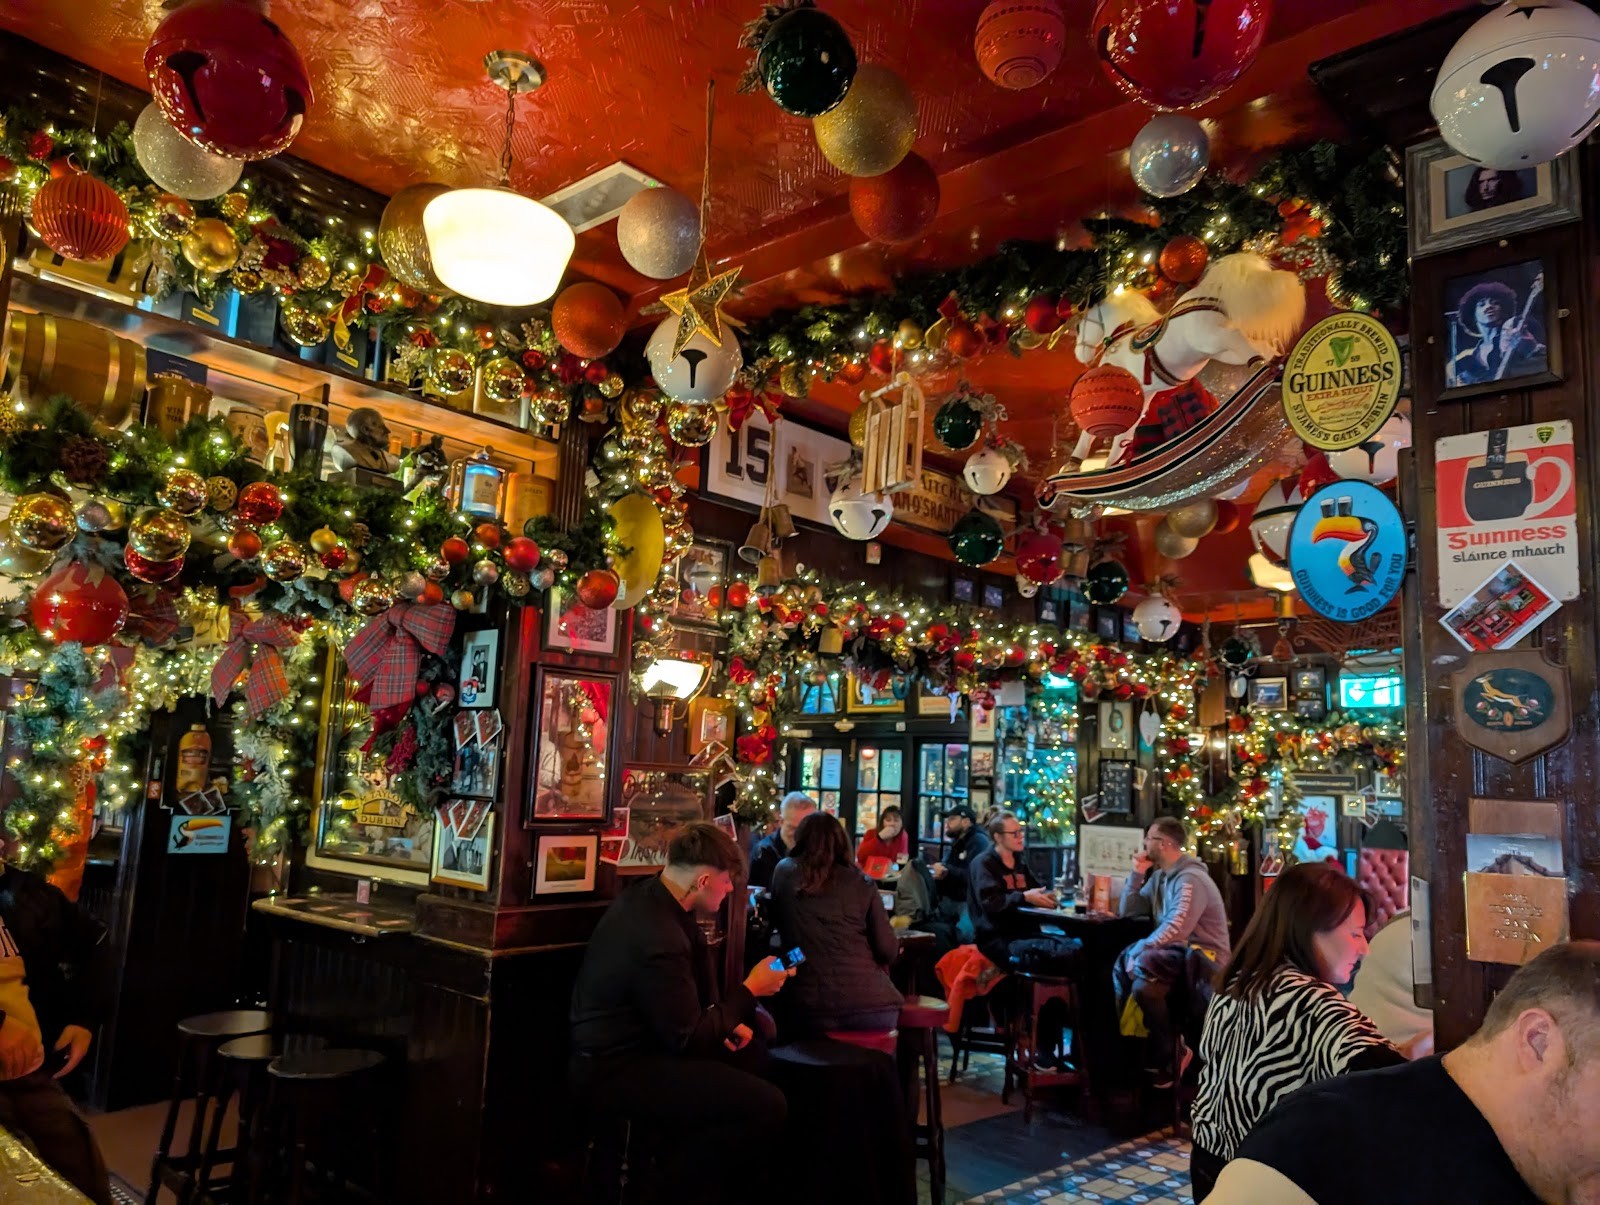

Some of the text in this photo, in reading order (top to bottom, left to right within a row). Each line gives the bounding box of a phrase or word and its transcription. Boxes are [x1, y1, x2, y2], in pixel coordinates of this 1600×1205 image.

[1294, 320, 1389, 370] TRADITIONALLY BREWED
[1289, 361, 1394, 394] GUINNESS
[1306, 384, 1375, 402] EXTRA STOUT
[1332, 427, 1361, 442] GATE
[1360, 393, 1390, 430] DUBLIN
[726, 425, 771, 486] 15
[1296, 553, 1403, 618] GUINNESS IS GOOD FOR YOU
[361, 815, 402, 825] DUBLIN
